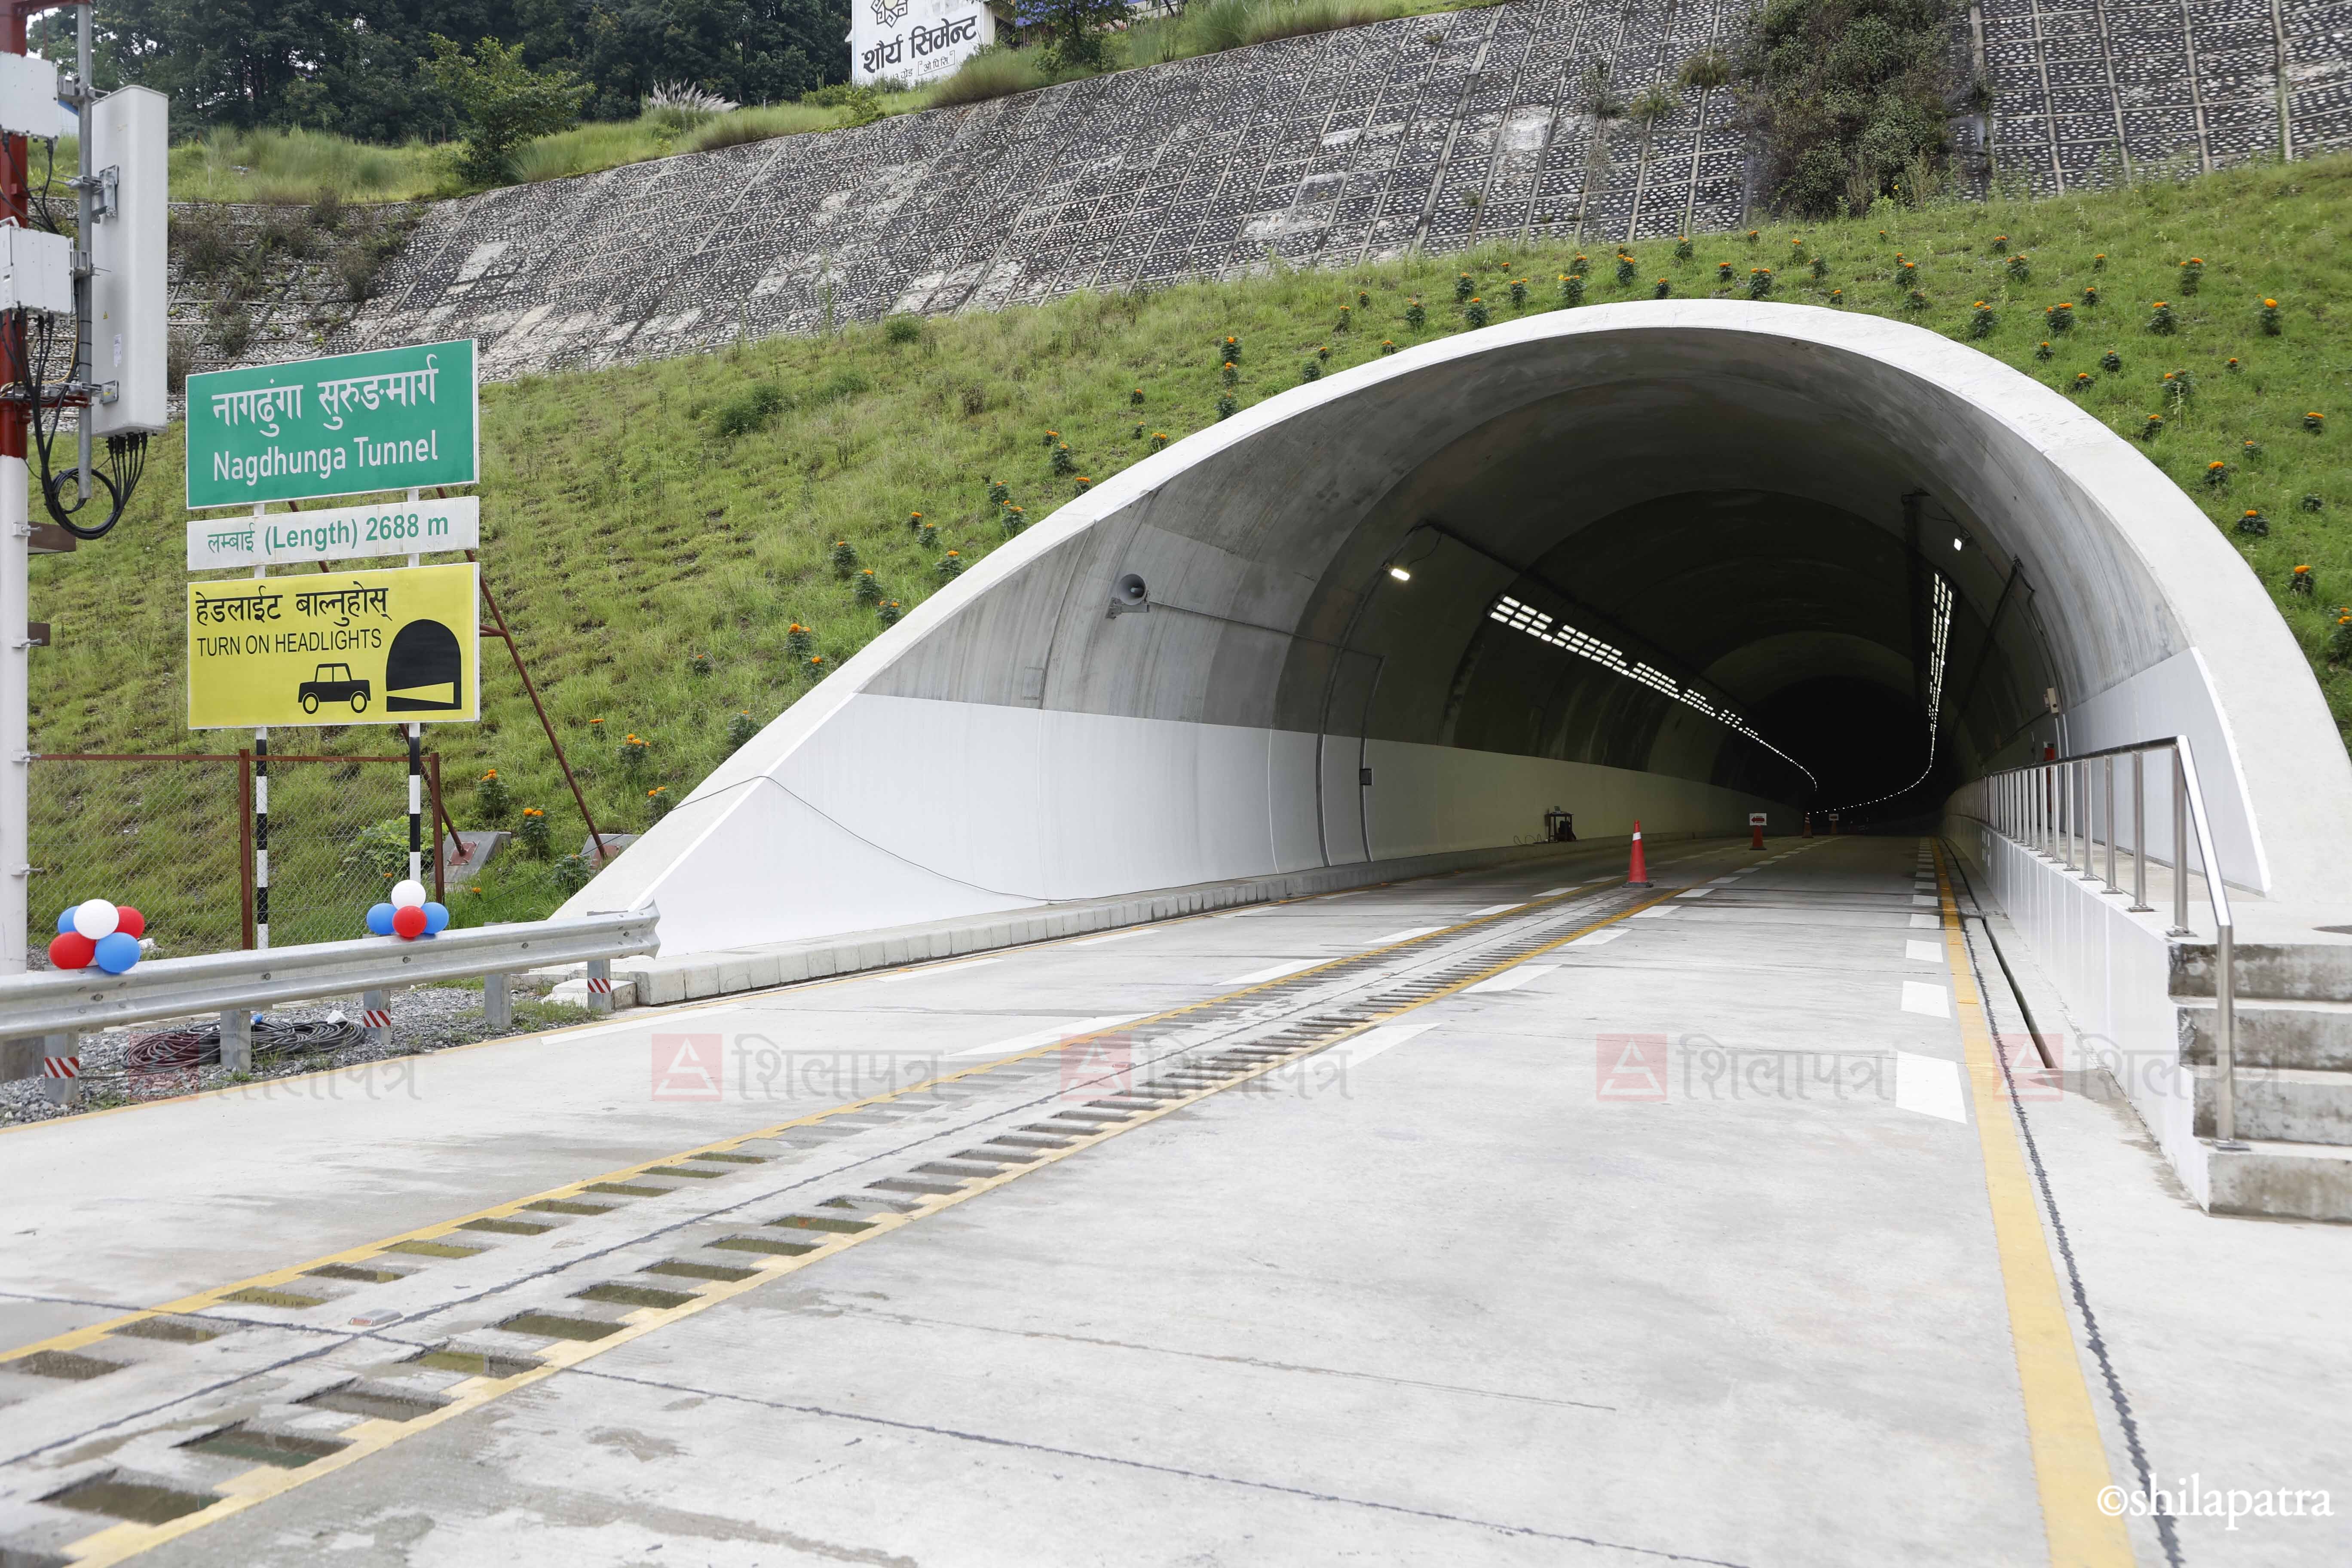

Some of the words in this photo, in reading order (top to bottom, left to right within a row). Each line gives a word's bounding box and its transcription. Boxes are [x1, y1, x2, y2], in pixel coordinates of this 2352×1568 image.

[909, 15, 977, 58] सिमेन्ट
[211, 378, 303, 437] नागढुंगा
[317, 354, 439, 430] सुरुङमार्ग
[214, 446, 346, 486] Nagdhunga
[353, 429, 438, 467] Tunnel
[207, 522, 255, 553] लम्बाई
[265, 518, 358, 555] (Length)
[366, 514, 419, 541] 2688
[428, 517, 448, 536] m
[196, 585, 283, 626] हेडलाईट
[296, 581, 392, 627] बाल्नुहोस्
[197, 636, 240, 656] TURN
[246, 635, 269, 654] ON
[276, 628, 381, 653] HEADLIGHTS
